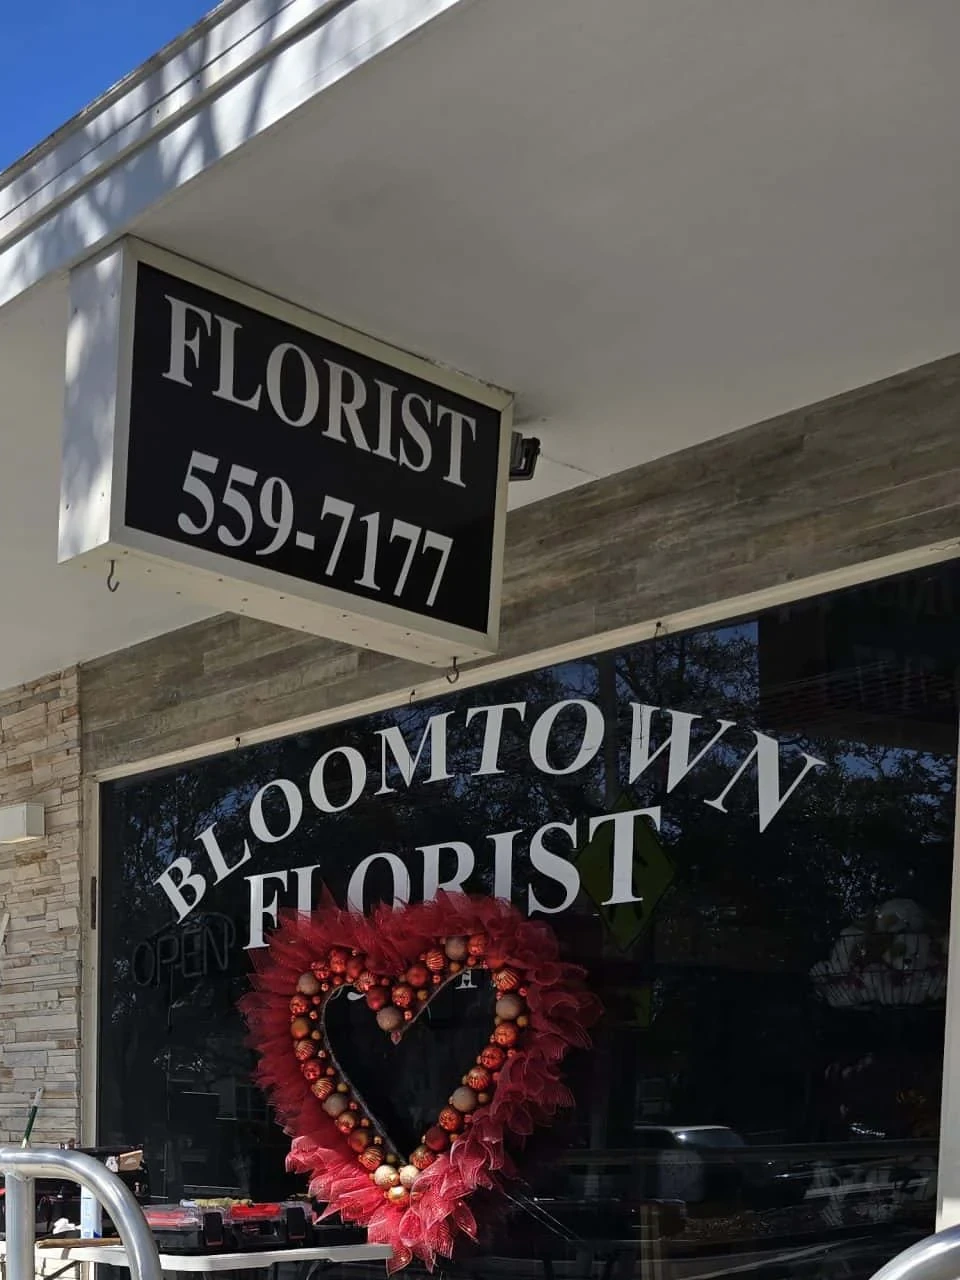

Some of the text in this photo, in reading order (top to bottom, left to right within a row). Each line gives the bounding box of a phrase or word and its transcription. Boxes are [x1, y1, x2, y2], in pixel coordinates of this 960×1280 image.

[163, 294, 477, 488] FLORIST
[177, 450, 454, 607] 559-7177
[153, 699, 826, 924] BLOOMTOWN
[131, 922, 230, 987] OPEN
